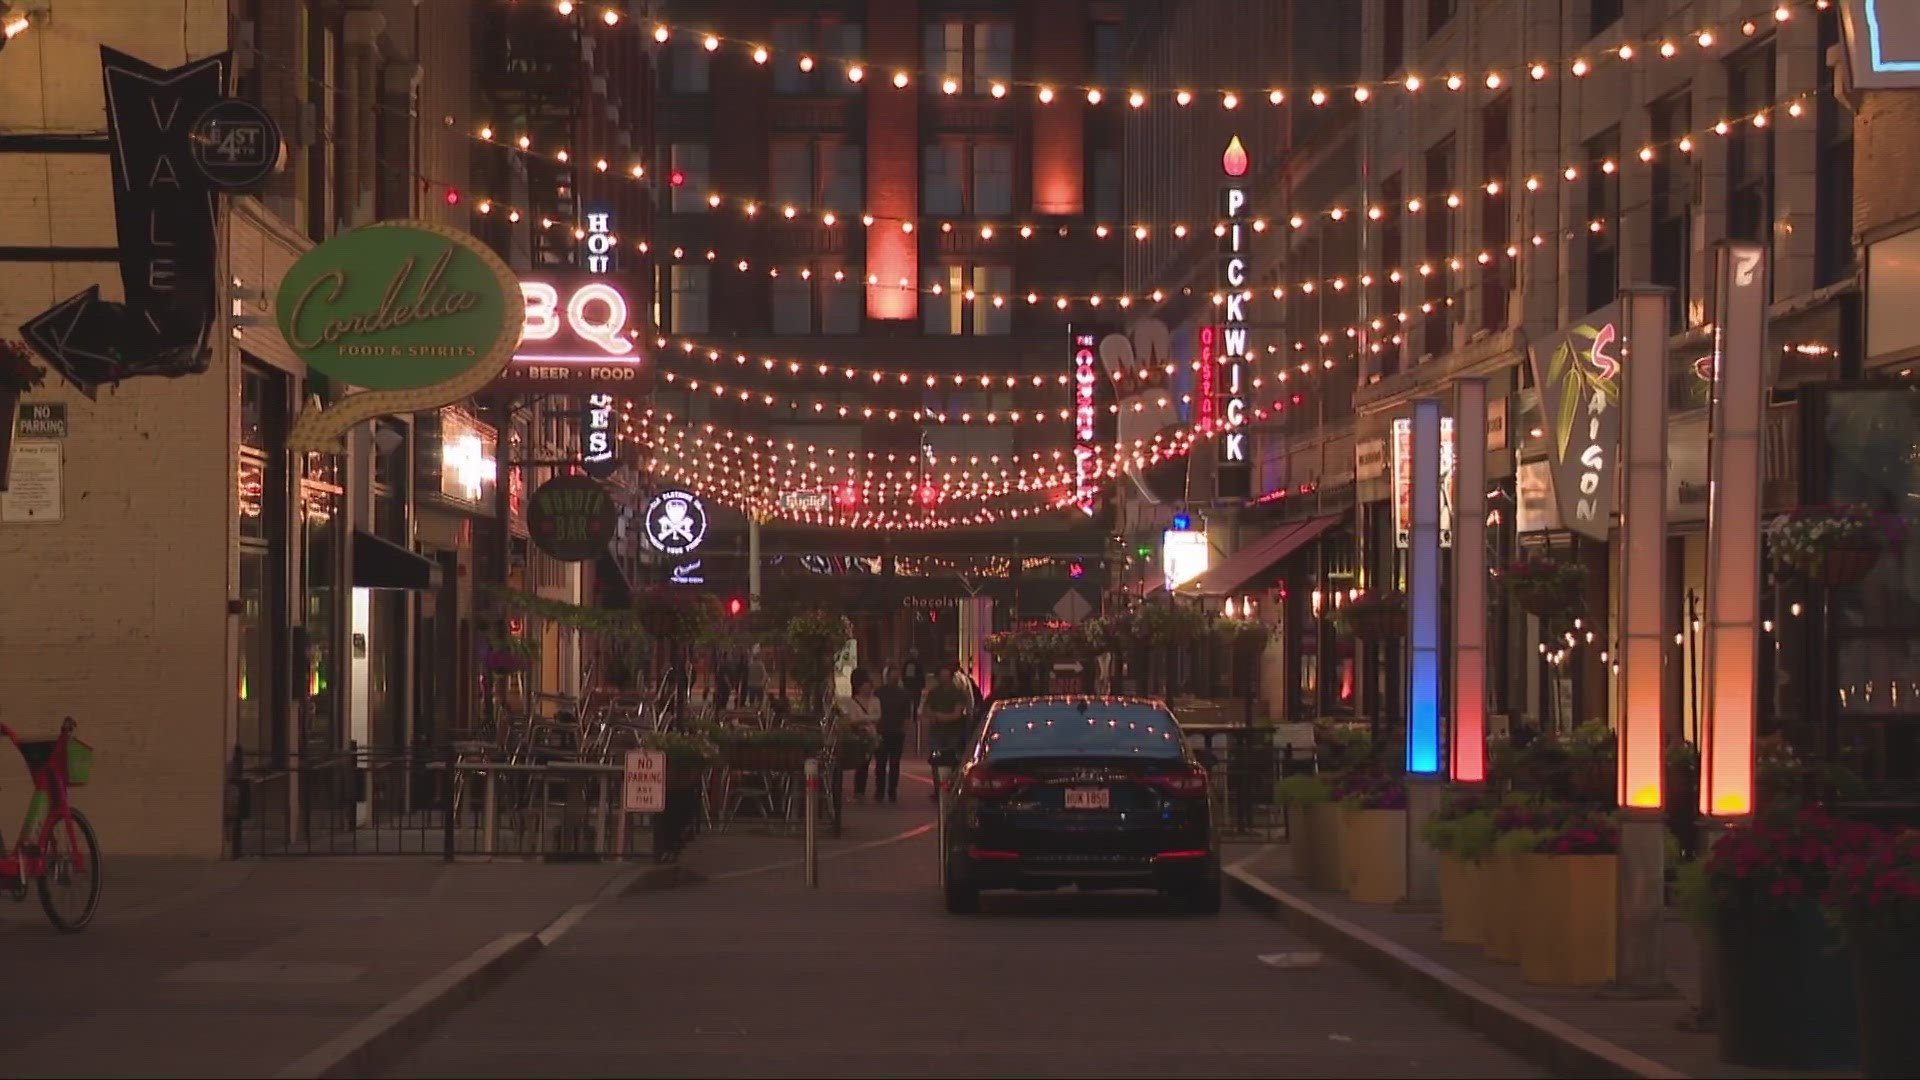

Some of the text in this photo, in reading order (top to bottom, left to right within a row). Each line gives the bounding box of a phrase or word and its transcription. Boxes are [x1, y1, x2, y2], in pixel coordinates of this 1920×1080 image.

[587, 213, 609, 273] HOU
[290, 246, 478, 349] Cordelia
[1225, 189, 1246, 460] PICKWICK
[338, 344, 477, 357] FOOD & SPIRITS
[528, 366, 636, 381] BEER FOOD
[33, 405, 51, 419] NO
[20, 418, 65, 434] PARKING
[1576, 323, 1616, 521] SAIGON
[540, 488, 603, 516] WONDER
[555, 516, 588, 541] BAR
[903, 595, 960, 608] Chocolat
[637, 758, 653, 770] NO
[628, 771, 662, 784] PARKING
[637, 786, 653, 794] ANY
[636, 795, 654, 805] TIME
